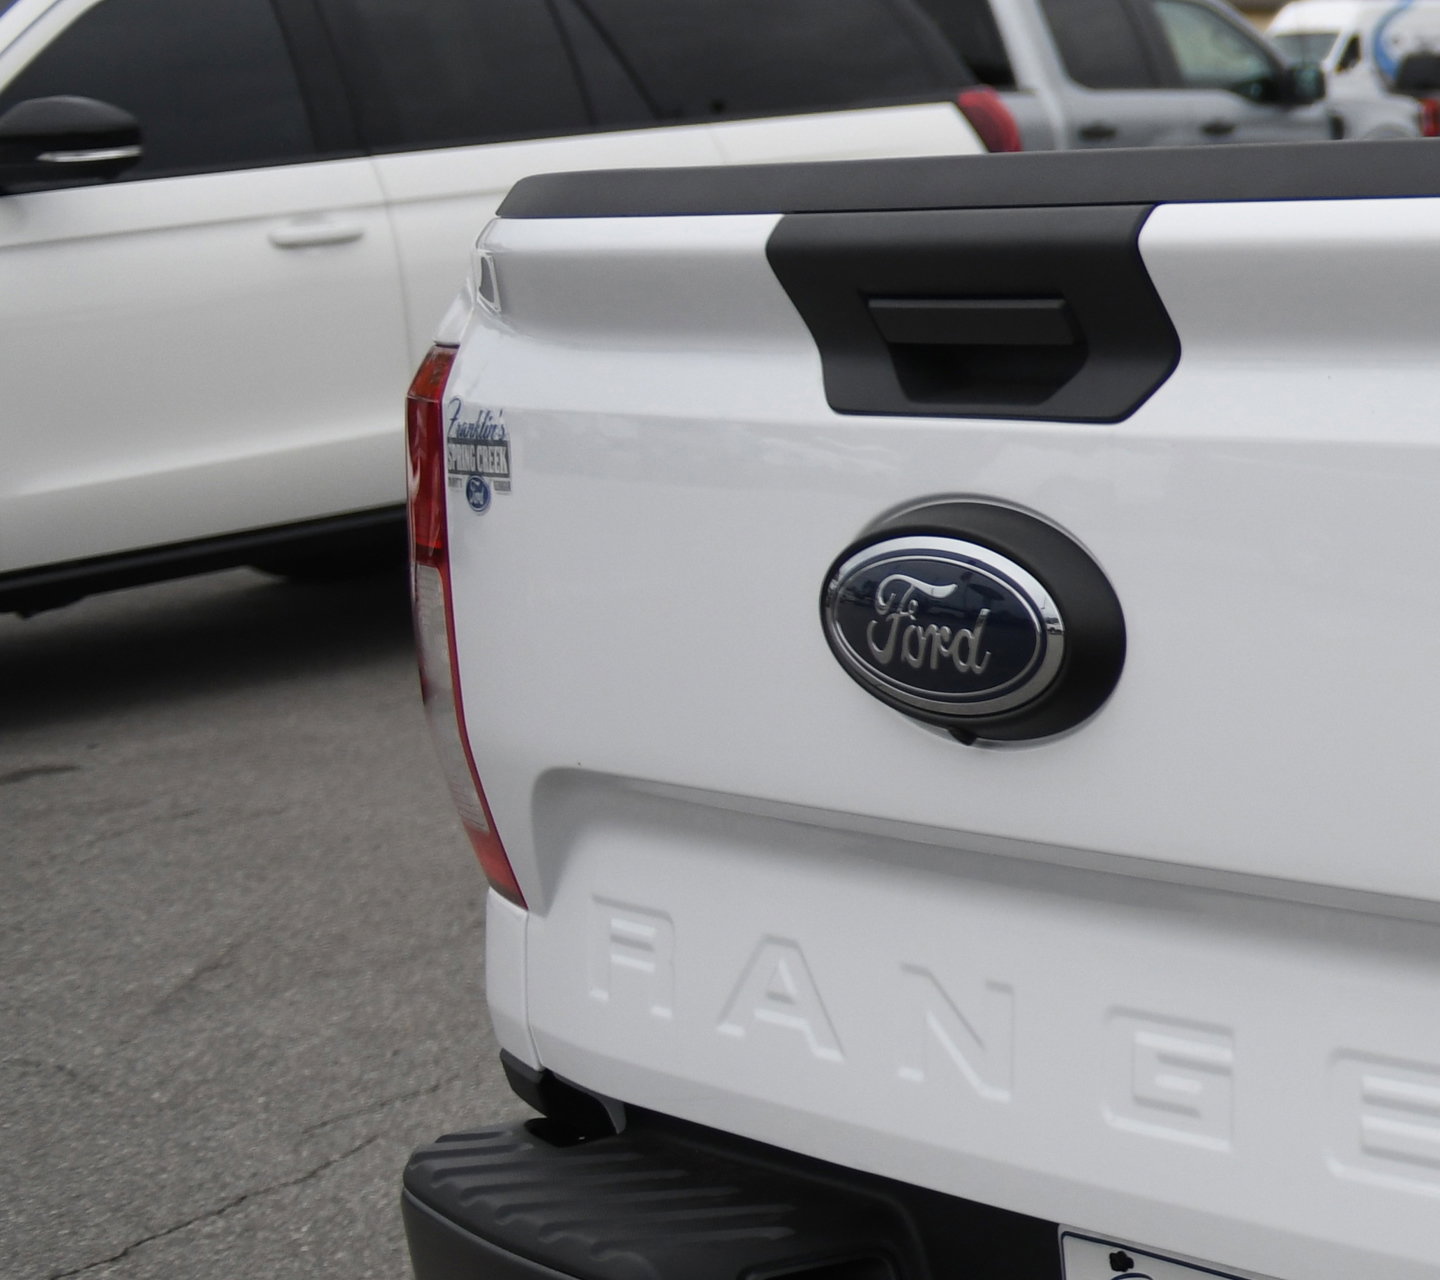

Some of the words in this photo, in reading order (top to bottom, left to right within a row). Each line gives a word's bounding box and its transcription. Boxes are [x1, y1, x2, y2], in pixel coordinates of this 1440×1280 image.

[447, 397, 506, 440] Franklin's
[476, 445, 509, 474] CREEK
[866, 573, 993, 675] Ford
